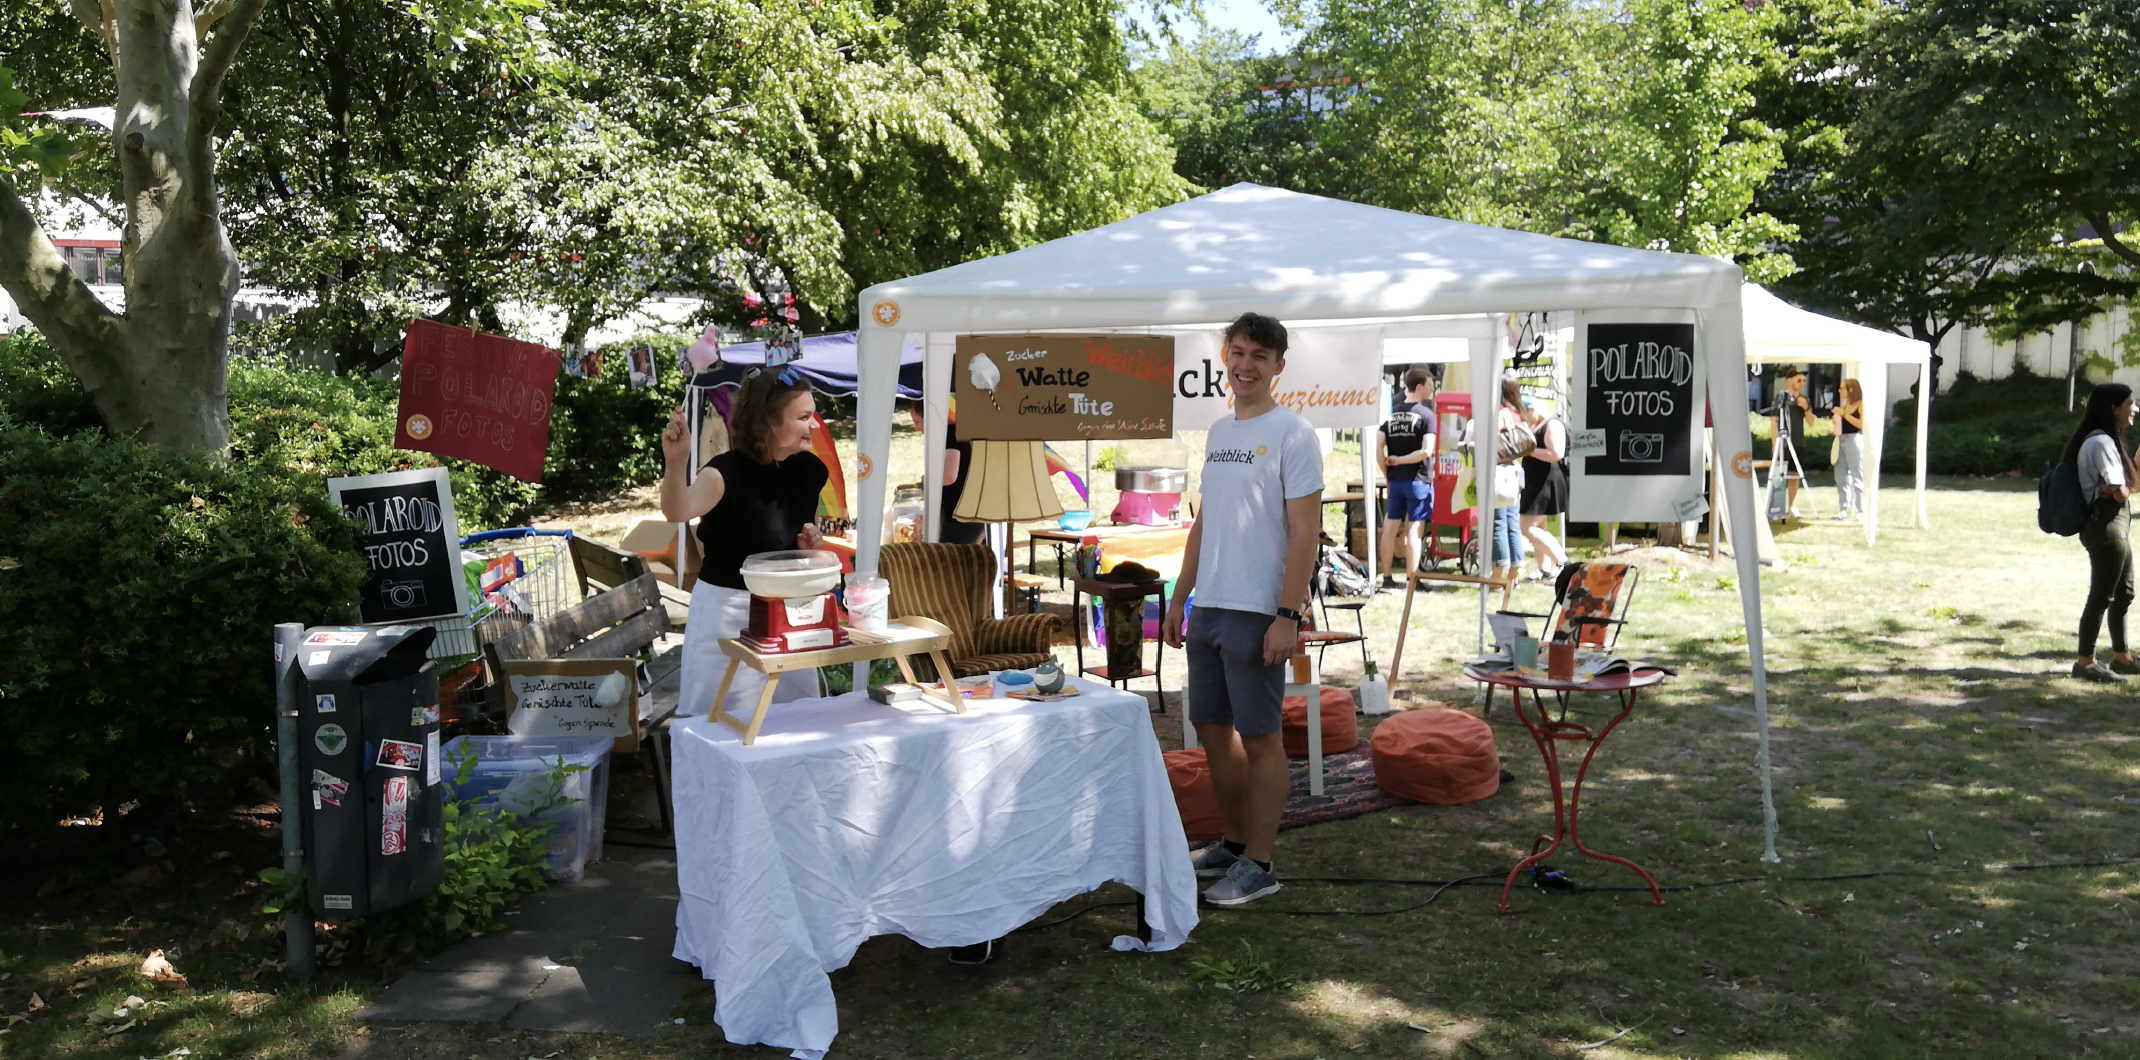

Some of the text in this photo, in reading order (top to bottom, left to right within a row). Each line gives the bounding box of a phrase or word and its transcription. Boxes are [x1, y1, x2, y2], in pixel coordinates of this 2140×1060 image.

[420, 325, 541, 383] FESTIVAL
[1006, 348, 1048, 362] Zucker
[1590, 341, 1693, 388] POLAROID
[1015, 366, 1090, 387] Watte
[412, 363, 548, 425] POLAROID
[1068, 393, 1114, 416] Tüte
[1603, 390, 1675, 416] FOTOS
[440, 409, 515, 451] FOTOS
[1206, 449, 1255, 464] Weitblick
[364, 538, 429, 571] FOTOS
[521, 679, 596, 693] Zuckerwatte
[521, 695, 573, 708] Gemischte
